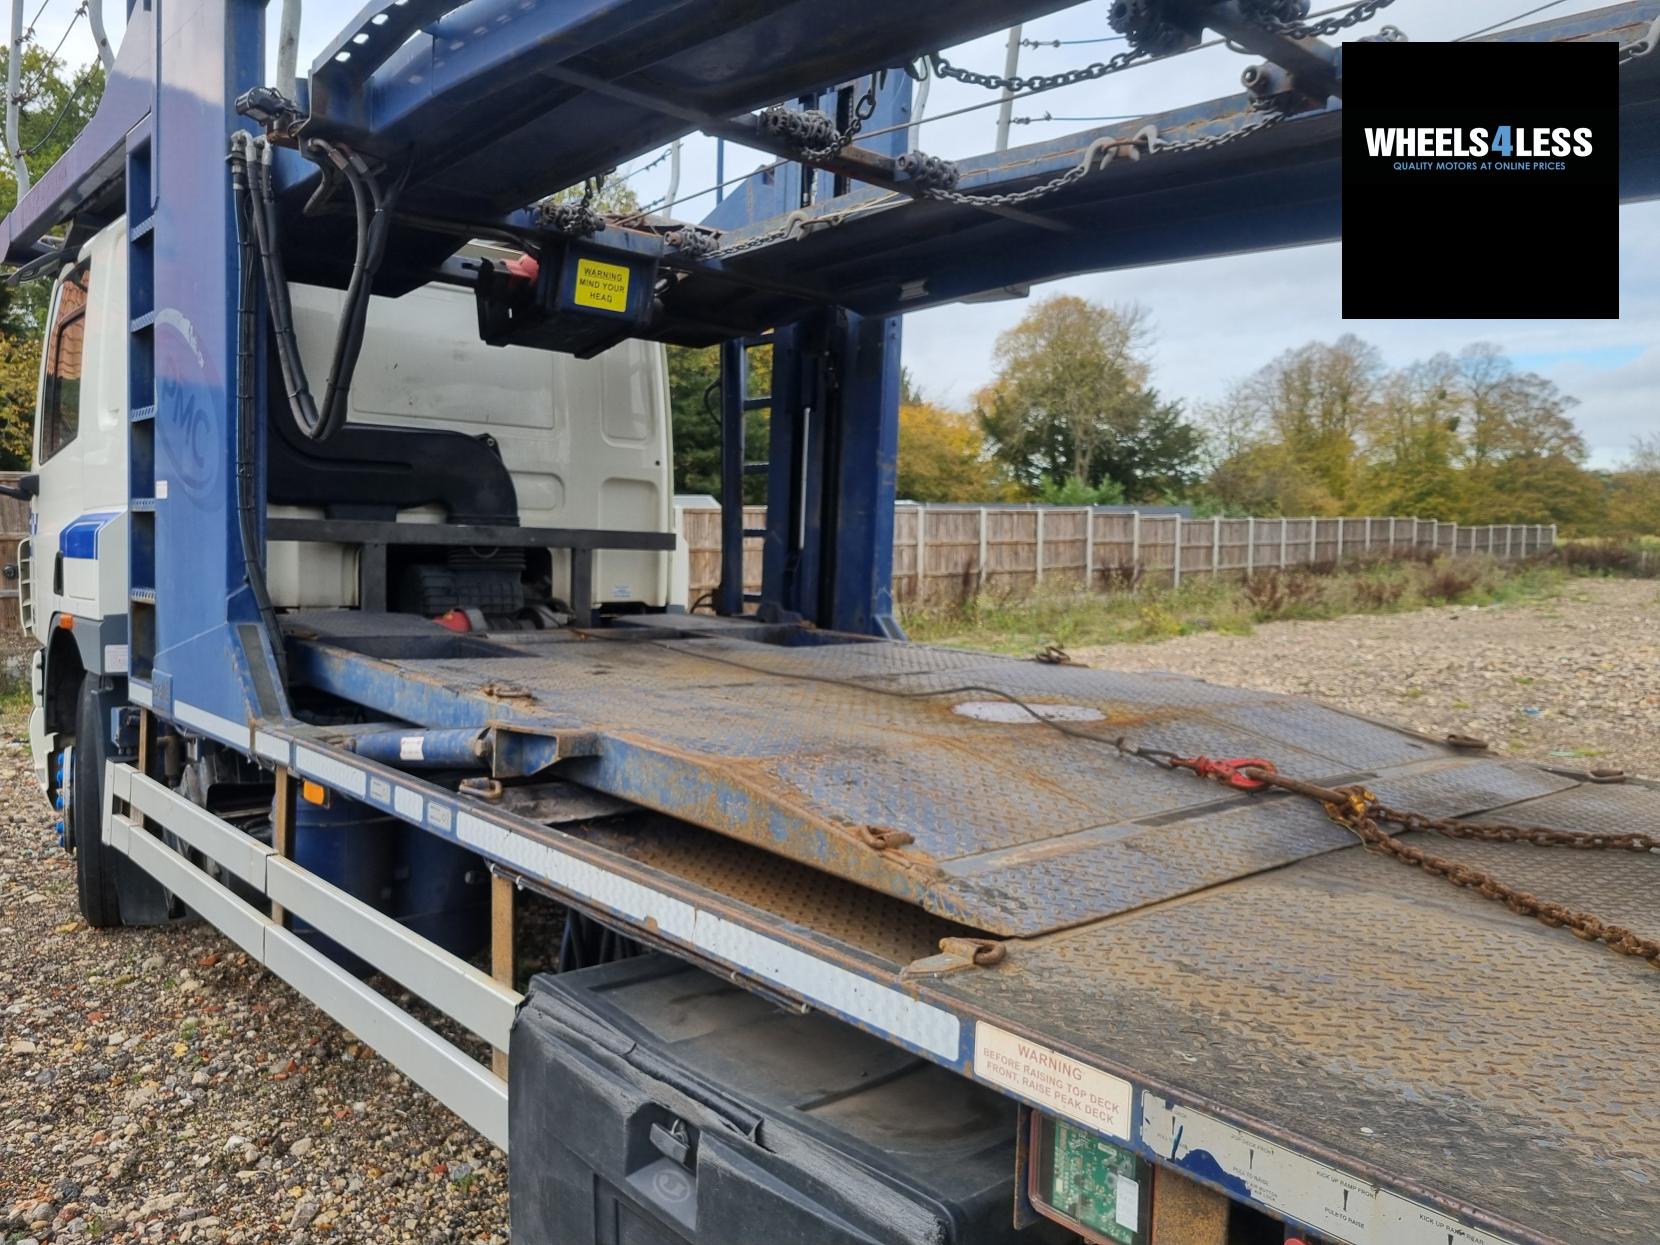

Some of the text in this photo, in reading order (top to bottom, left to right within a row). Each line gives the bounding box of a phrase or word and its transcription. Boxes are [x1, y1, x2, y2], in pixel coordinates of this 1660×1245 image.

[584, 267, 623, 282] WARNING
[579, 278, 625, 294] MIND YOUR
[589, 291, 613, 303] HEAD
[1017, 1043, 1083, 1081] WARNING
[983, 1047, 1120, 1114] BEFORE RAISING TOP DECK
[986, 1061, 1114, 1126] FRONT, RAISE PEAK DECK
[1419, 1213, 1434, 1225] KICK
[1435, 1220, 1445, 1228] UP
